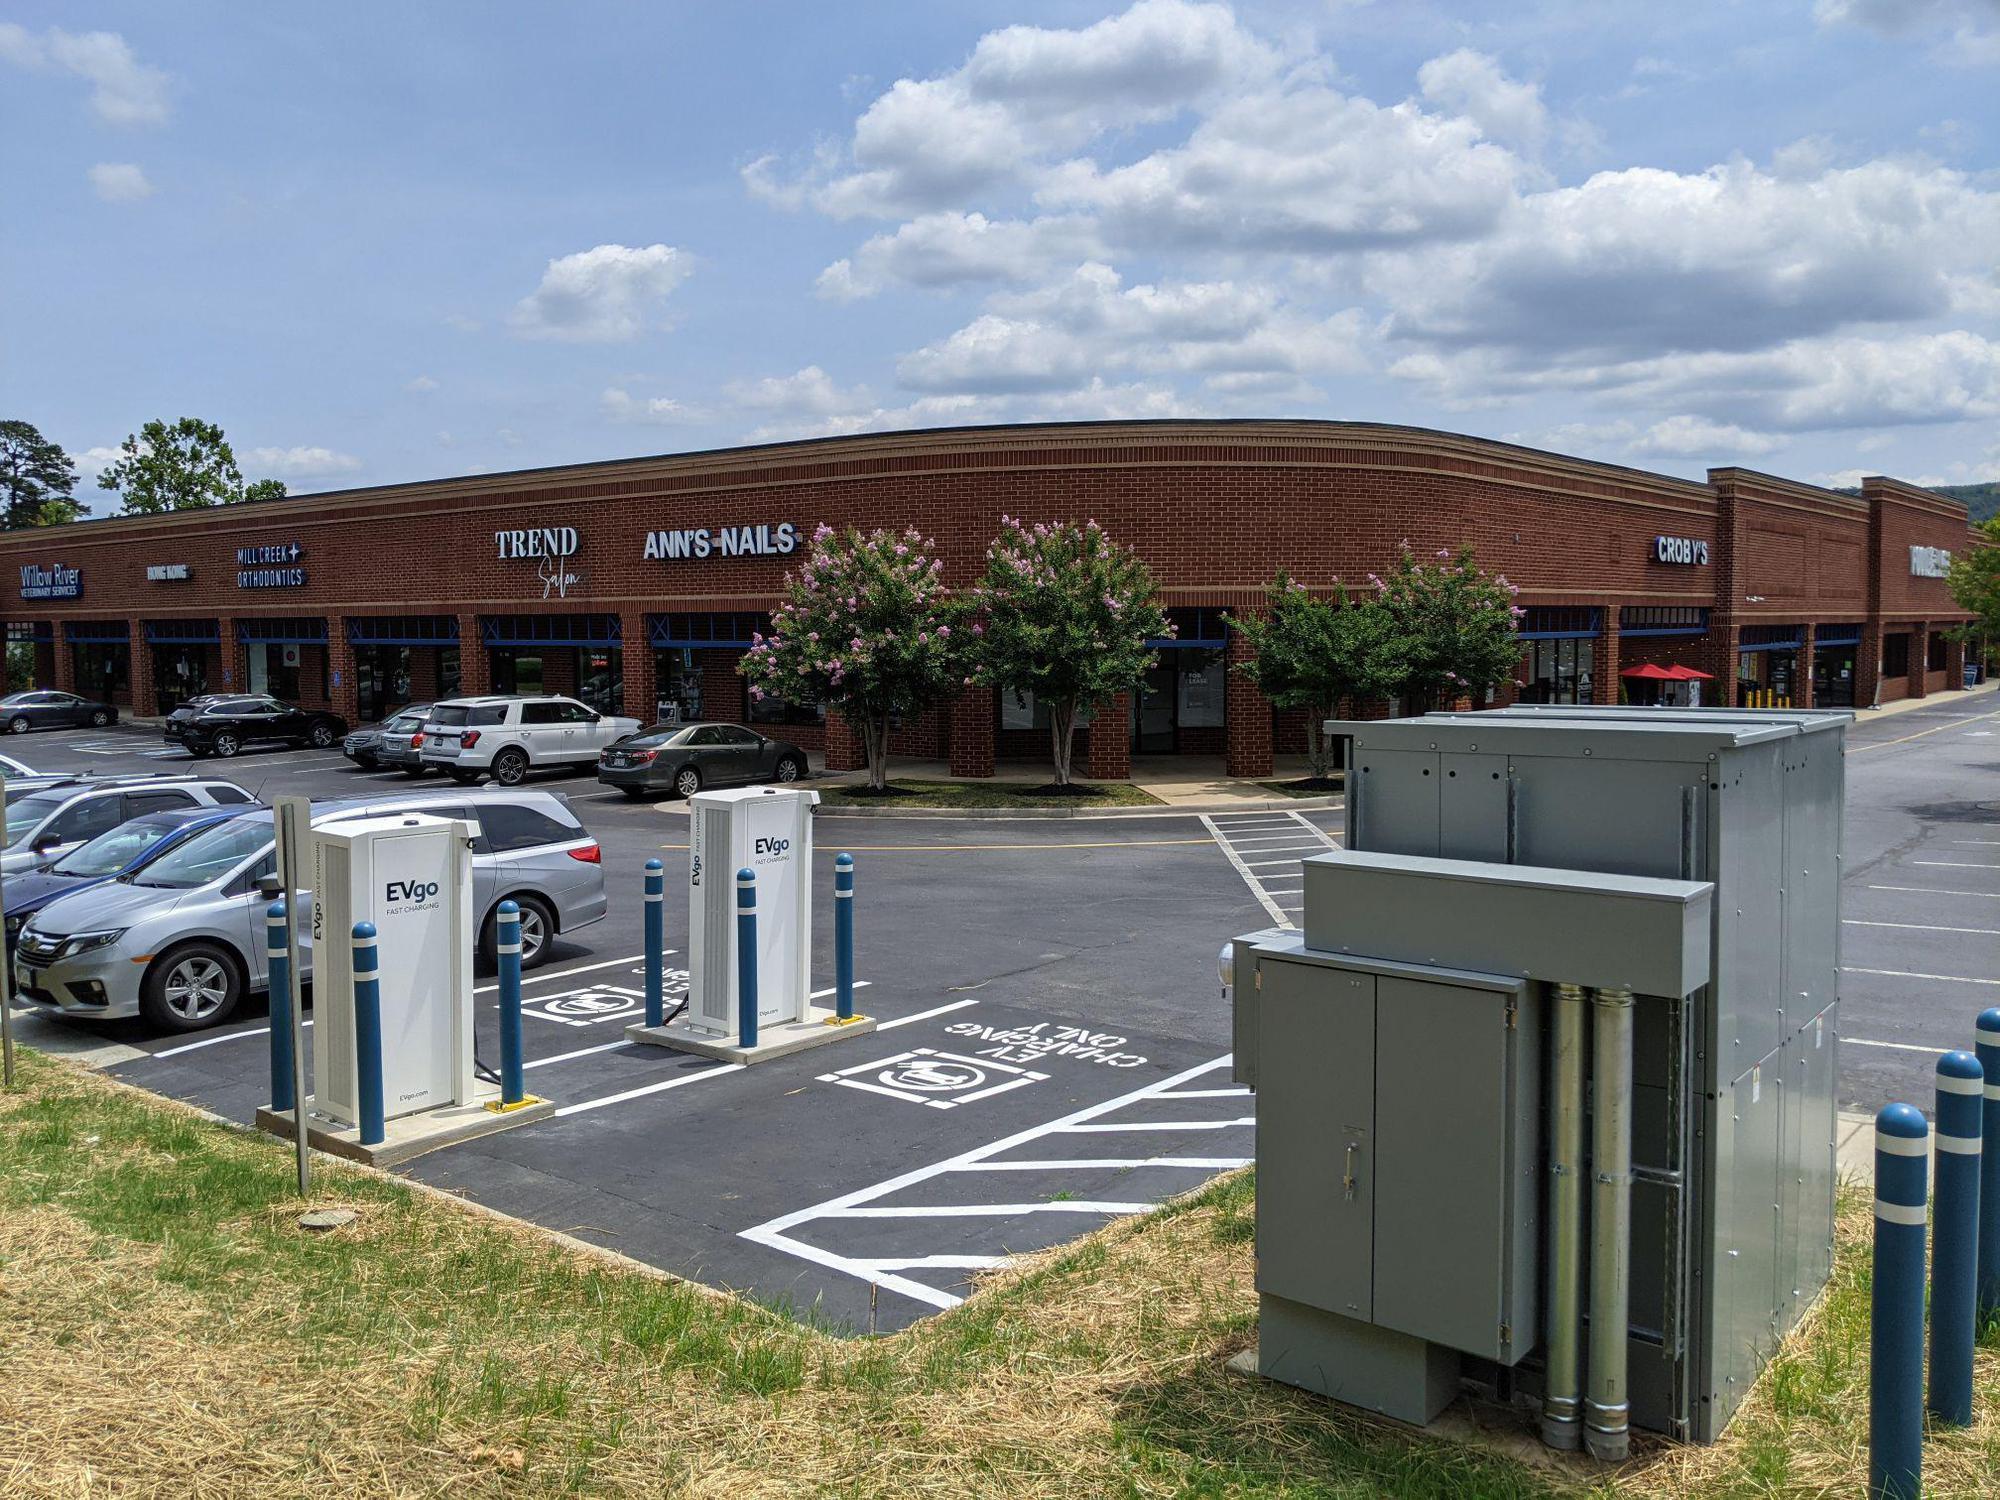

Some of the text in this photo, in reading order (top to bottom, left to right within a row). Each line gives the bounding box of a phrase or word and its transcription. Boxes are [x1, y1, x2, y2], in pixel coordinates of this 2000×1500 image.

[495, 527, 578, 559] TREND
[643, 522, 794, 560] ANN'S NAILS
[1658, 536, 1708, 565] CROBY'S
[237, 545, 287, 565] MILL CREEK
[20, 563, 79, 587] Willow River
[237, 569, 302, 588] ORTHODONTICS
[538, 554, 581, 599] Salon
[52, 585, 77, 597] SERVICES
[755, 837, 789, 856] EVgo
[692, 855, 702, 886] EVgo
[755, 858, 767, 866] FAST
[386, 880, 439, 904] EVgo
[314, 902, 324, 940] EVgo
[386, 902, 440, 916] FAST CHARGING
[944, 1023, 1148, 1067] CHARGING
[1013, 1022, 1127, 1048] ONLY
[975, 1046, 1047, 1063] EV
[399, 1090, 429, 1102] EVgo.com
